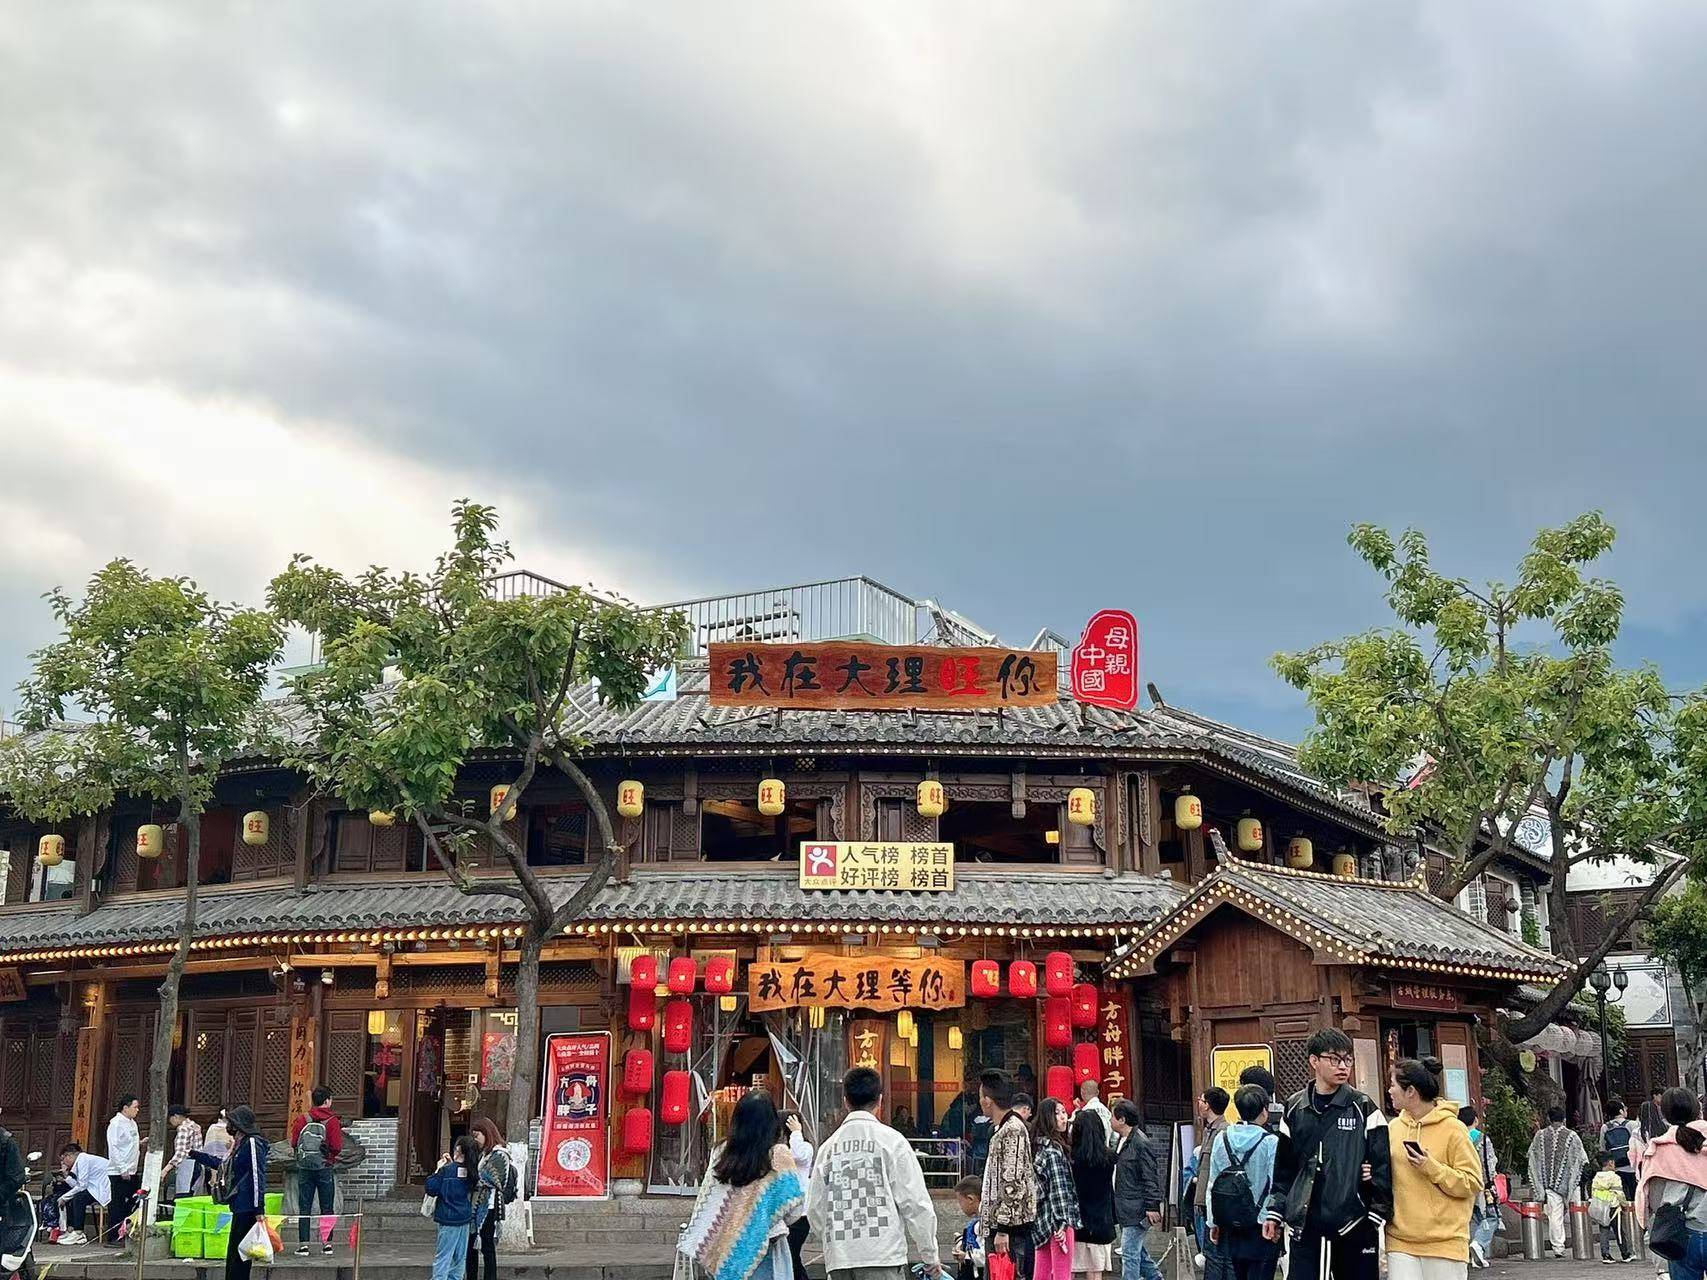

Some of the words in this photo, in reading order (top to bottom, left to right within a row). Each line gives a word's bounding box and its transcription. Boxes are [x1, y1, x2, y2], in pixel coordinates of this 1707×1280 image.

[1104, 627, 1130, 674] 母親
[728, 651, 1041, 699] 我在大理旺你
[1080, 643, 1106, 692] 中國
[761, 786, 774, 804] 旺
[929, 787, 943, 806] 旺
[1070, 797, 1083, 814] 旺
[248, 819, 263, 834] 旺
[842, 846, 899, 865] 人气榜
[911, 847, 949, 866] 榜首
[804, 877, 836, 886] 大众点评
[841, 867, 899, 887] 好评榜
[911, 868, 949, 888] 榜首
[758, 967, 947, 1004] 我在大理等你
